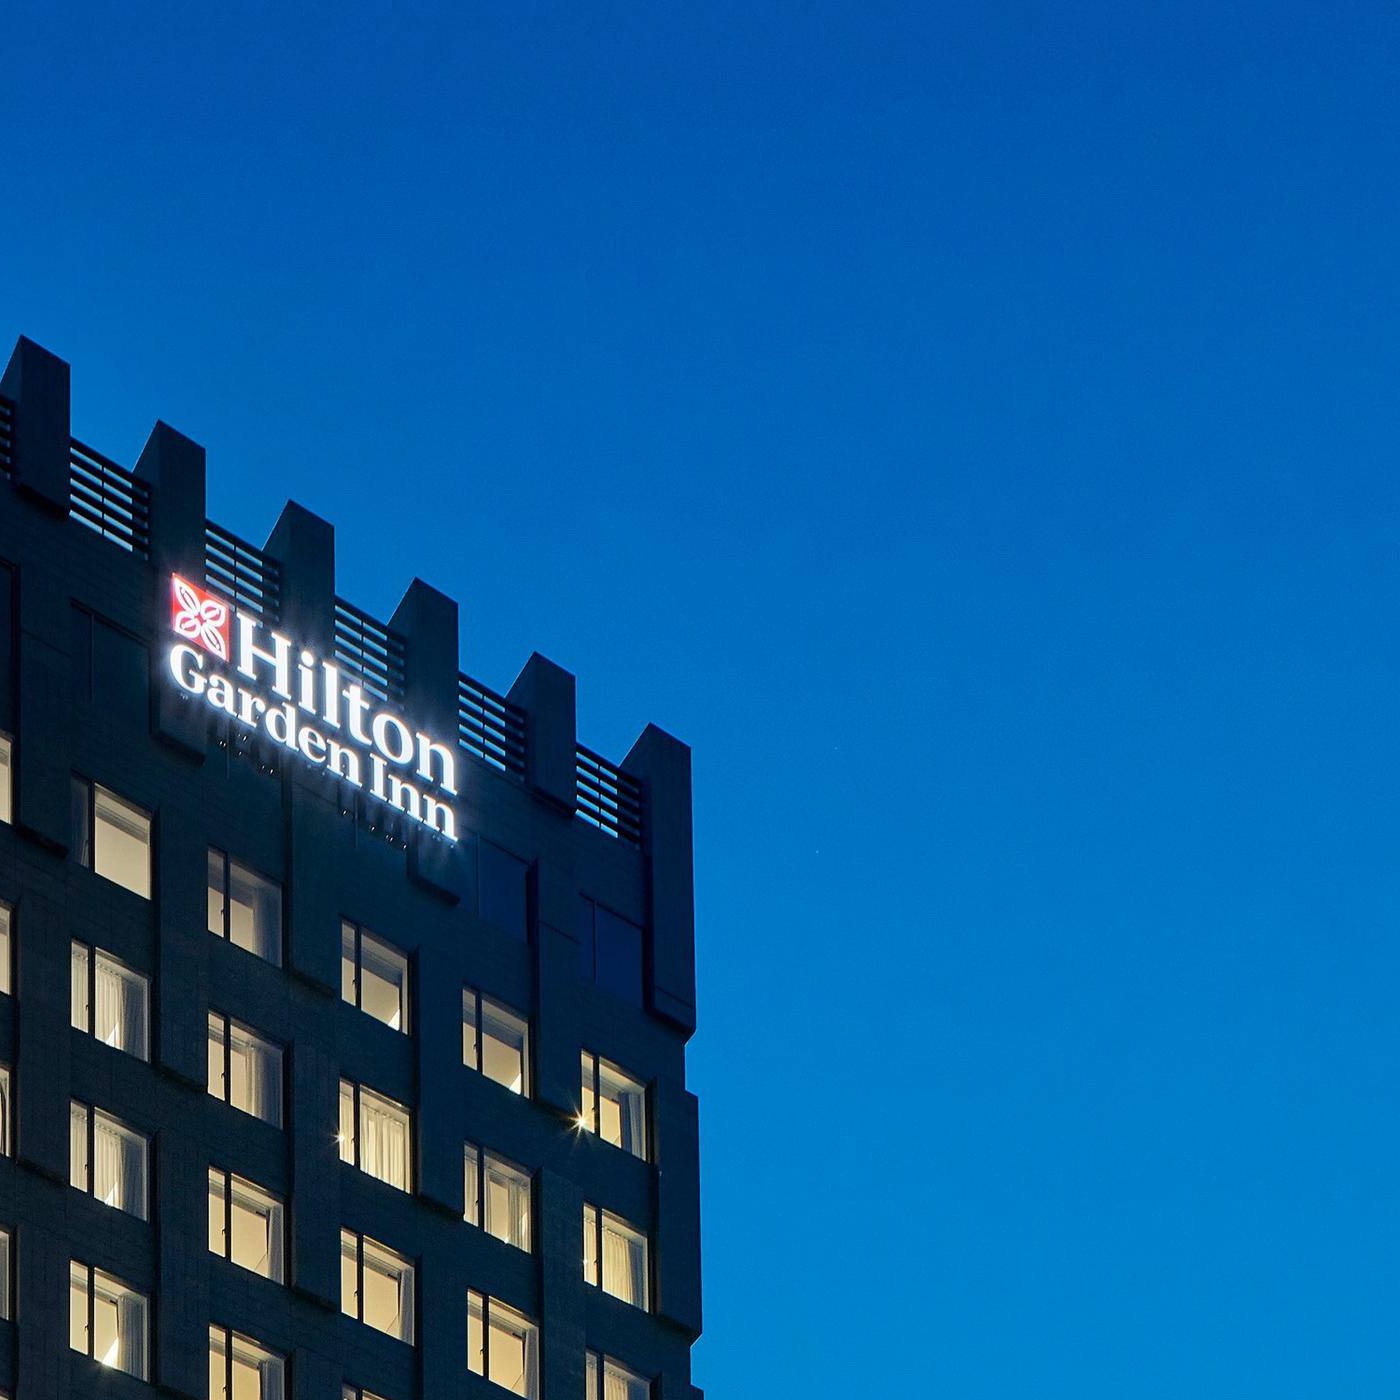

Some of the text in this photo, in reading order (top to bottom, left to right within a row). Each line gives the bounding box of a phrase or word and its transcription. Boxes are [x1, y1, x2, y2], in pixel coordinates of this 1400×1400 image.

[169, 644, 458, 843] Garden Inn
[236, 612, 458, 796] Hilton
